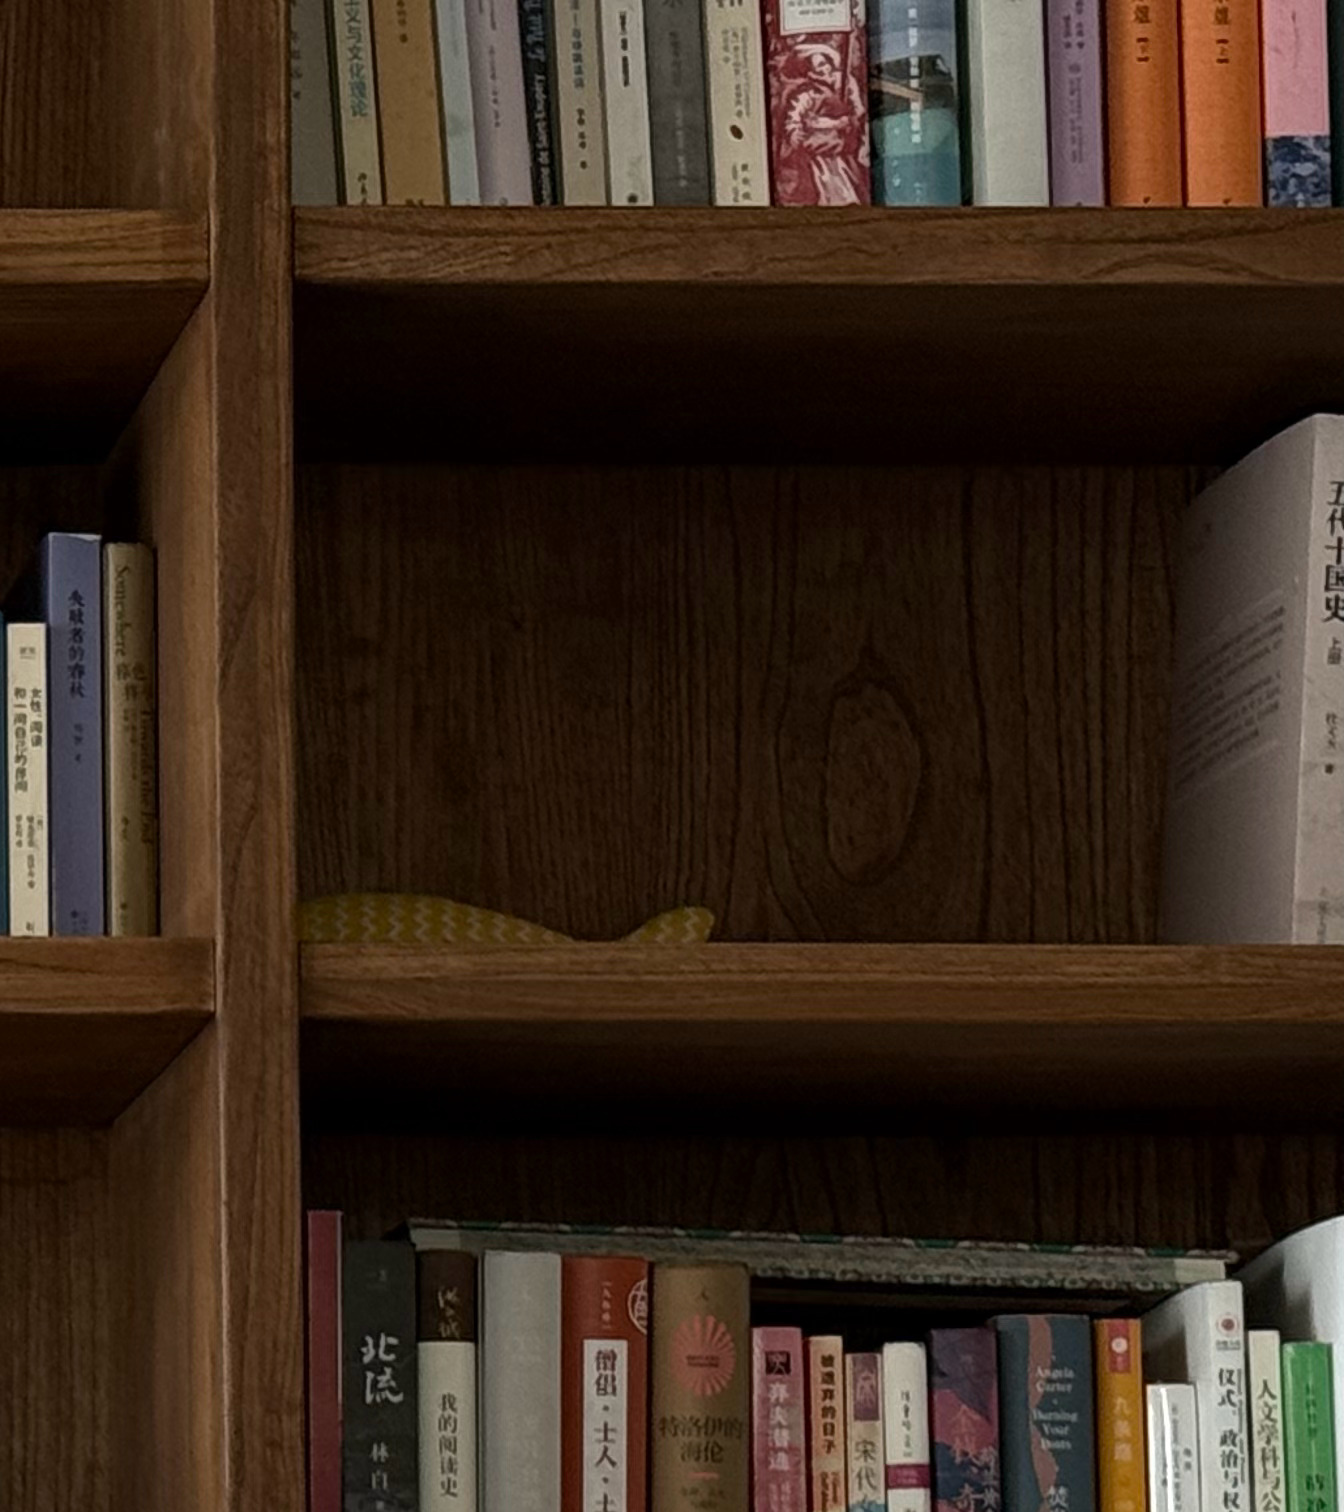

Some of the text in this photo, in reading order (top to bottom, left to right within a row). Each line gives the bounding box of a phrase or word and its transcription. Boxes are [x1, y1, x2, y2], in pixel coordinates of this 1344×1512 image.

[361, 1335, 403, 1404] 北流
[1036, 1367, 1075, 1381] Angela
[1036, 1381, 1072, 1393] Carter
[439, 1393, 458, 1498] 我的阅读史
